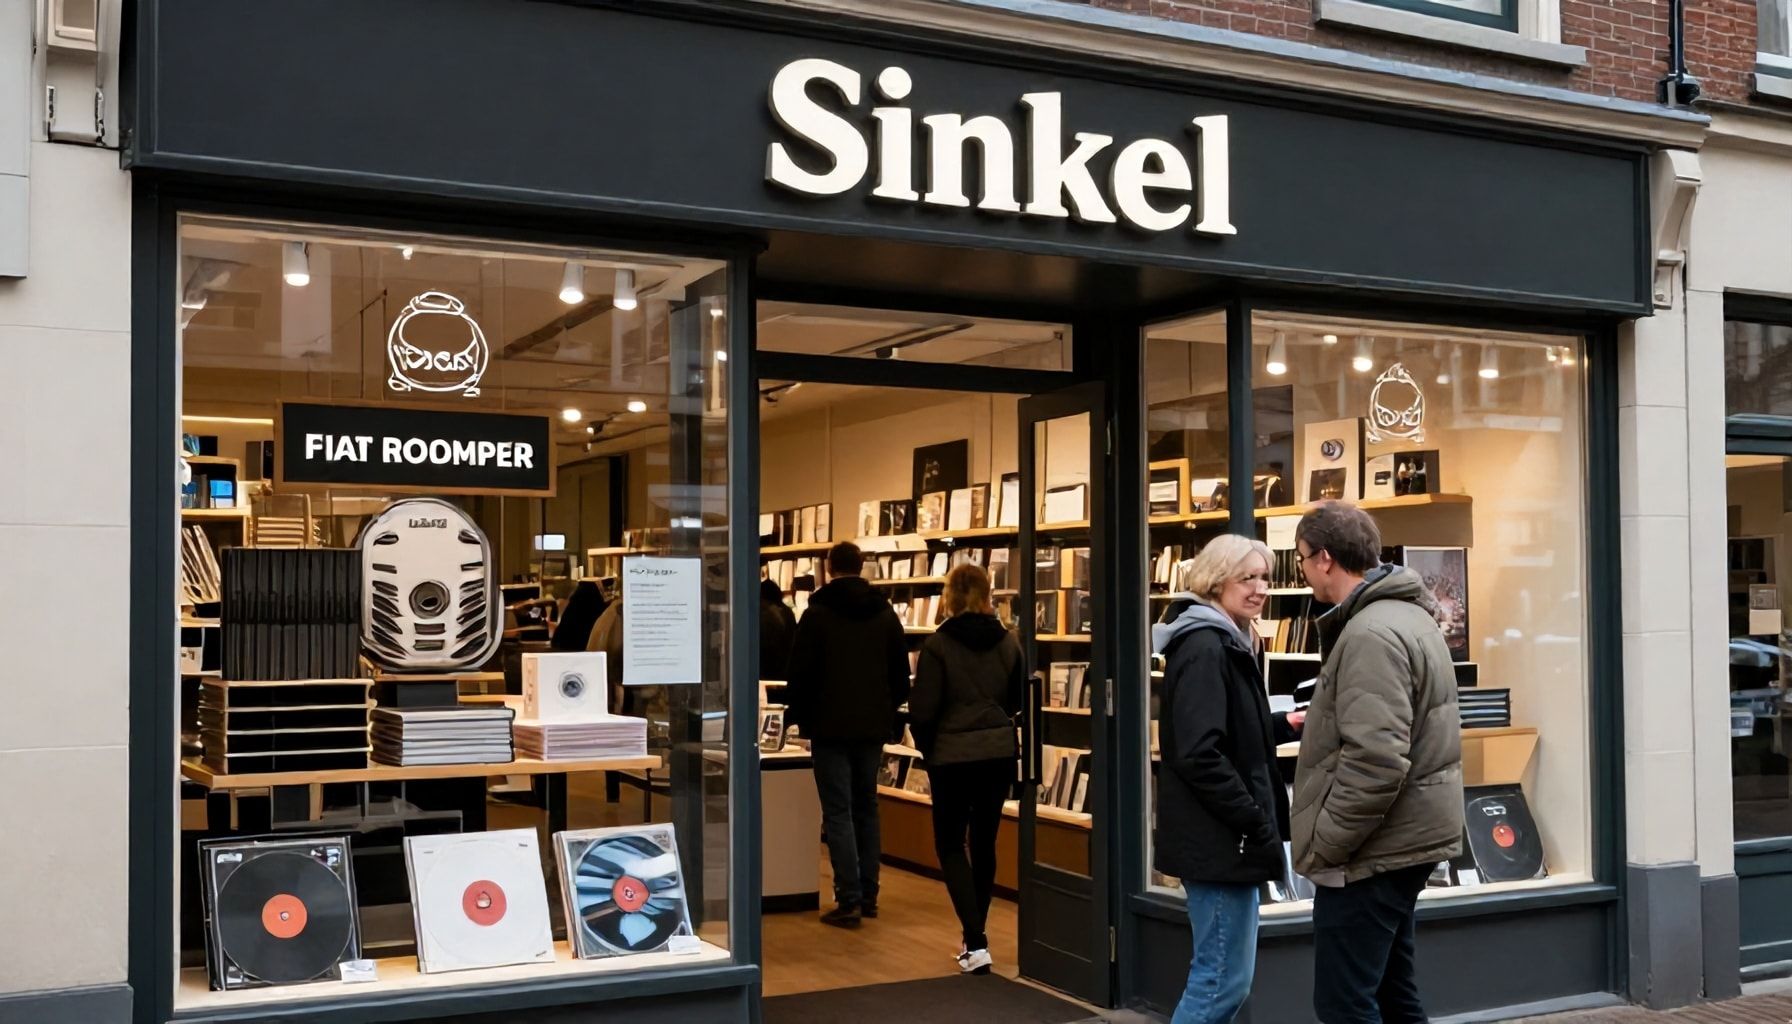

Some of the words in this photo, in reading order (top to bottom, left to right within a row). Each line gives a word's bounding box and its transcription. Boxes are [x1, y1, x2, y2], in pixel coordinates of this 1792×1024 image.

[768, 58, 1237, 235] Sinkel
[305, 433, 373, 462] FIAT
[382, 436, 534, 469] ROOMPER
